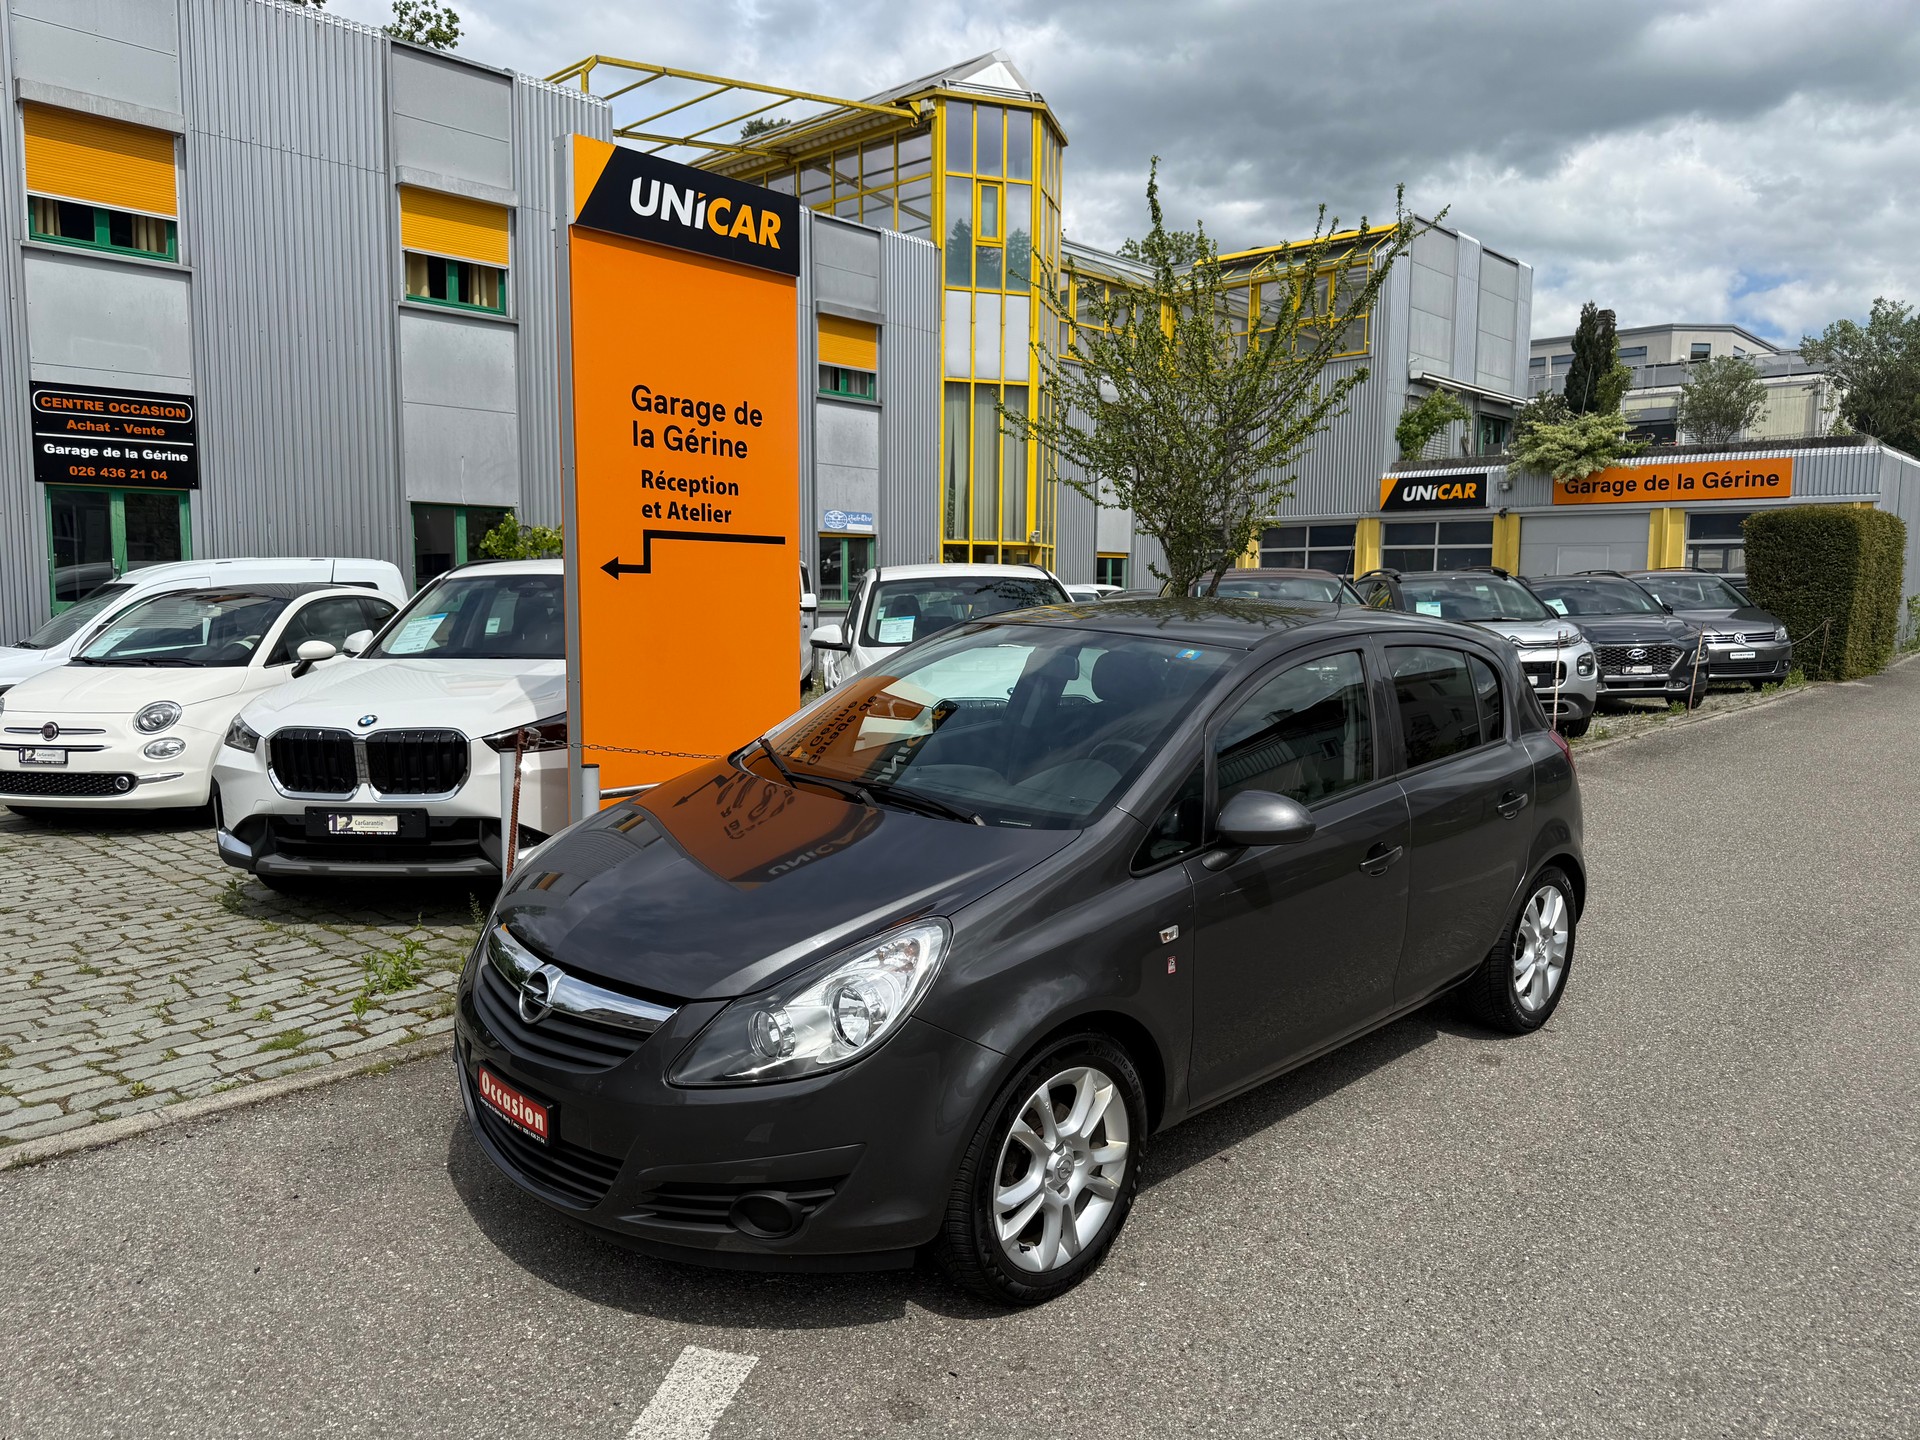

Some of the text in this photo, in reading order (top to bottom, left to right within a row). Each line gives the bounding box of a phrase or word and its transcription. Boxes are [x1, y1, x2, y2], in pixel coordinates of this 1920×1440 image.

[40, 397, 186, 418] CENTRE OCCASION
[631, 384, 763, 427] Garage de
[66, 419, 111, 432] Achat
[123, 423, 166, 436] Vente
[633, 420, 748, 459] la Gérine
[43, 443, 189, 462] Garage de la Gérine
[69, 465, 168, 480] 026 436 21 04
[641, 469, 739, 498] Réception
[1564, 470, 1779, 497] Garage de la Gérine
[641, 501, 732, 523] et Atelier
[354, 819, 384, 827] CarGarantie
[481, 1071, 544, 1132] Occasion
